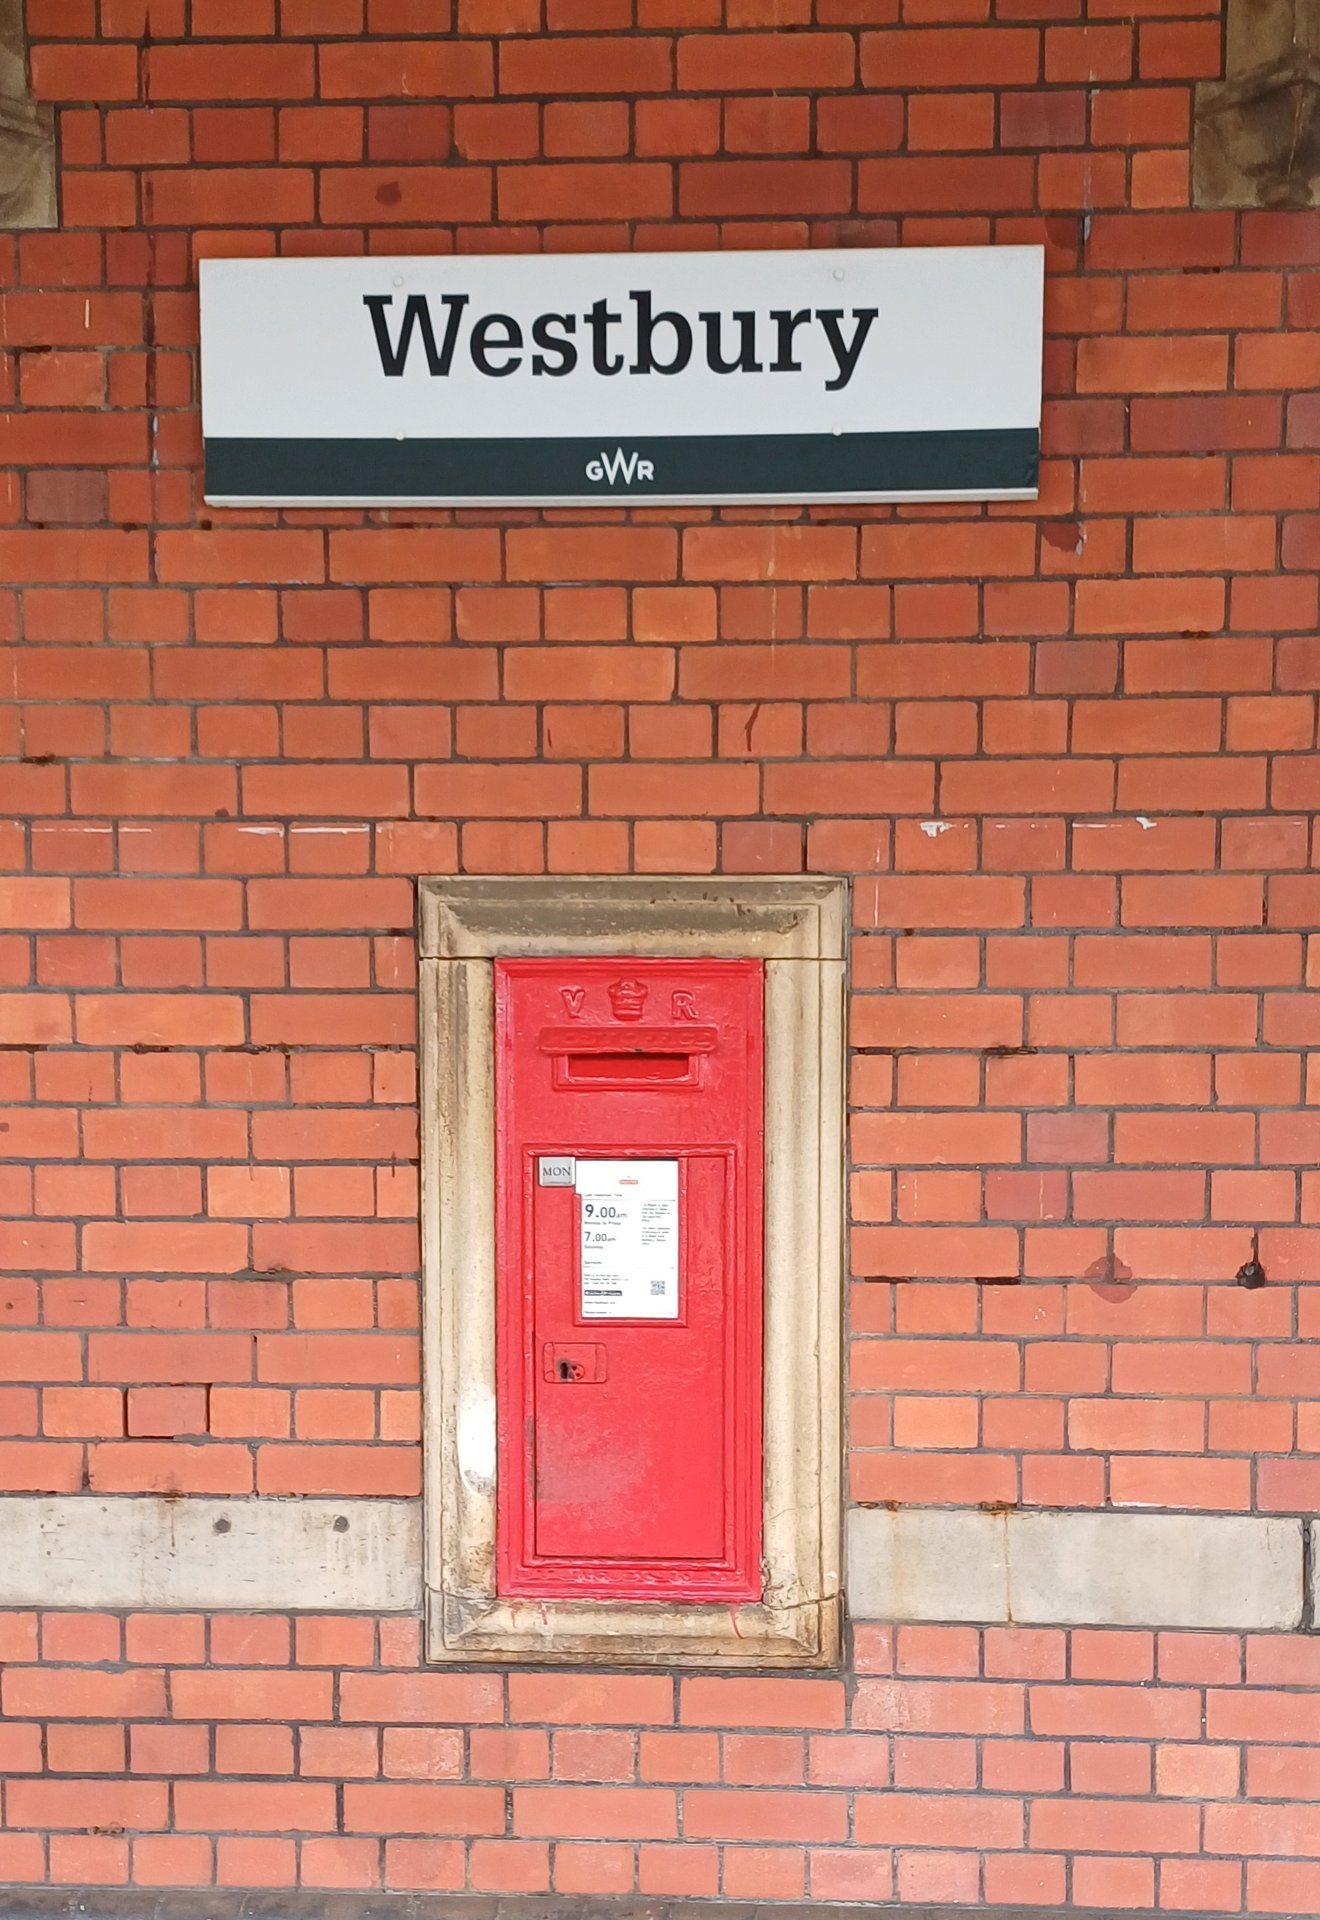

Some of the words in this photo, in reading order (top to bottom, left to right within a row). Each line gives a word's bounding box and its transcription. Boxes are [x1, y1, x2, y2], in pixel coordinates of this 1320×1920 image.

[363, 290, 878, 391] Westbury
[586, 447, 654, 485] GWR
[561, 989, 586, 1018] V
[672, 990, 698, 1020] R
[542, 1166, 571, 1177] MON
